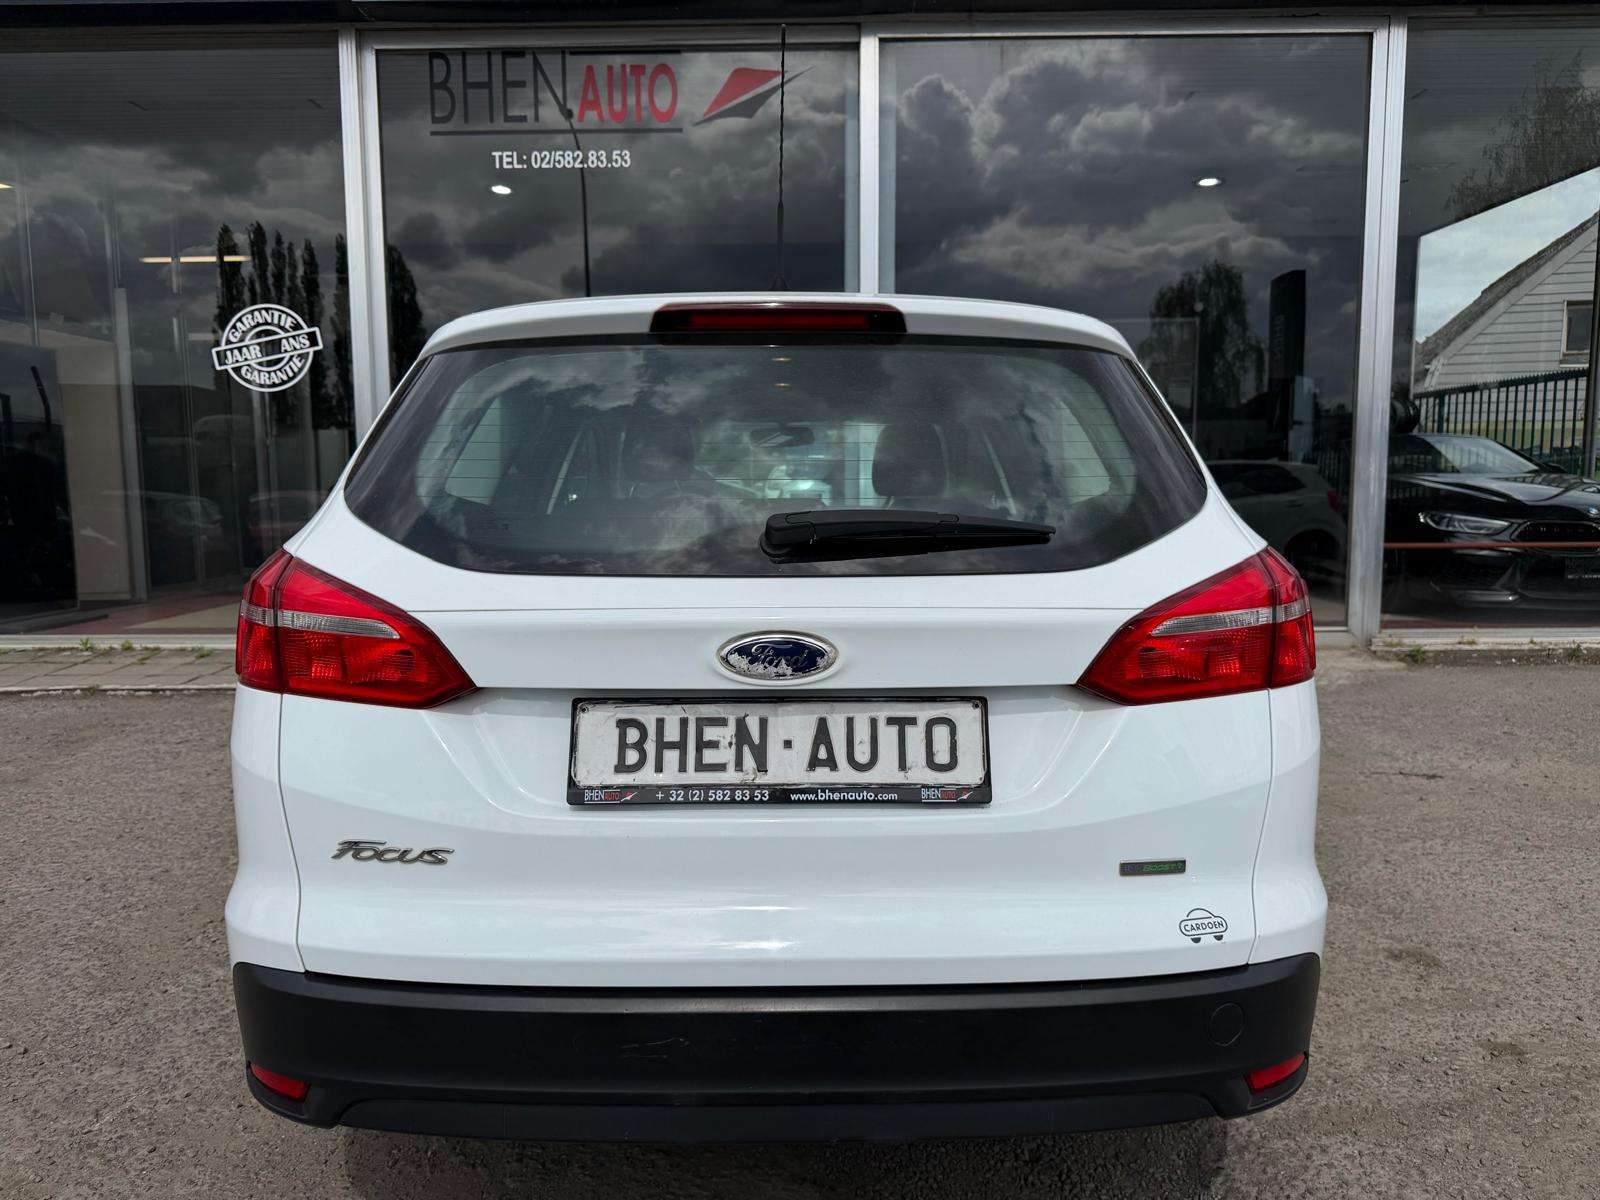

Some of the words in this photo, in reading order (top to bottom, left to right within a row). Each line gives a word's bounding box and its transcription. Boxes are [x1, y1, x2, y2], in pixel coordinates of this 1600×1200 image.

[428, 50, 569, 124] BHEN
[577, 62, 679, 123] AUTO
[491, 151, 527, 169] TEL:
[531, 150, 631, 168] 02/582.83.53
[228, 309, 297, 342] GARANTIE
[225, 345, 262, 364] JAAR
[280, 334, 310, 353] ANS
[240, 354, 305, 385] GARANTIE
[584, 790, 605, 801] BHEN
[669, 790, 684, 801] 32
[688, 789, 704, 802] (2)
[708, 790, 731, 801] 582
[735, 790, 750, 801] 83
[754, 790, 769, 801] 53
[790, 789, 898, 801] www.bhenauto.com
[921, 788, 941, 799] BHEN
[1183, 920, 1224, 932] CARDOEN
